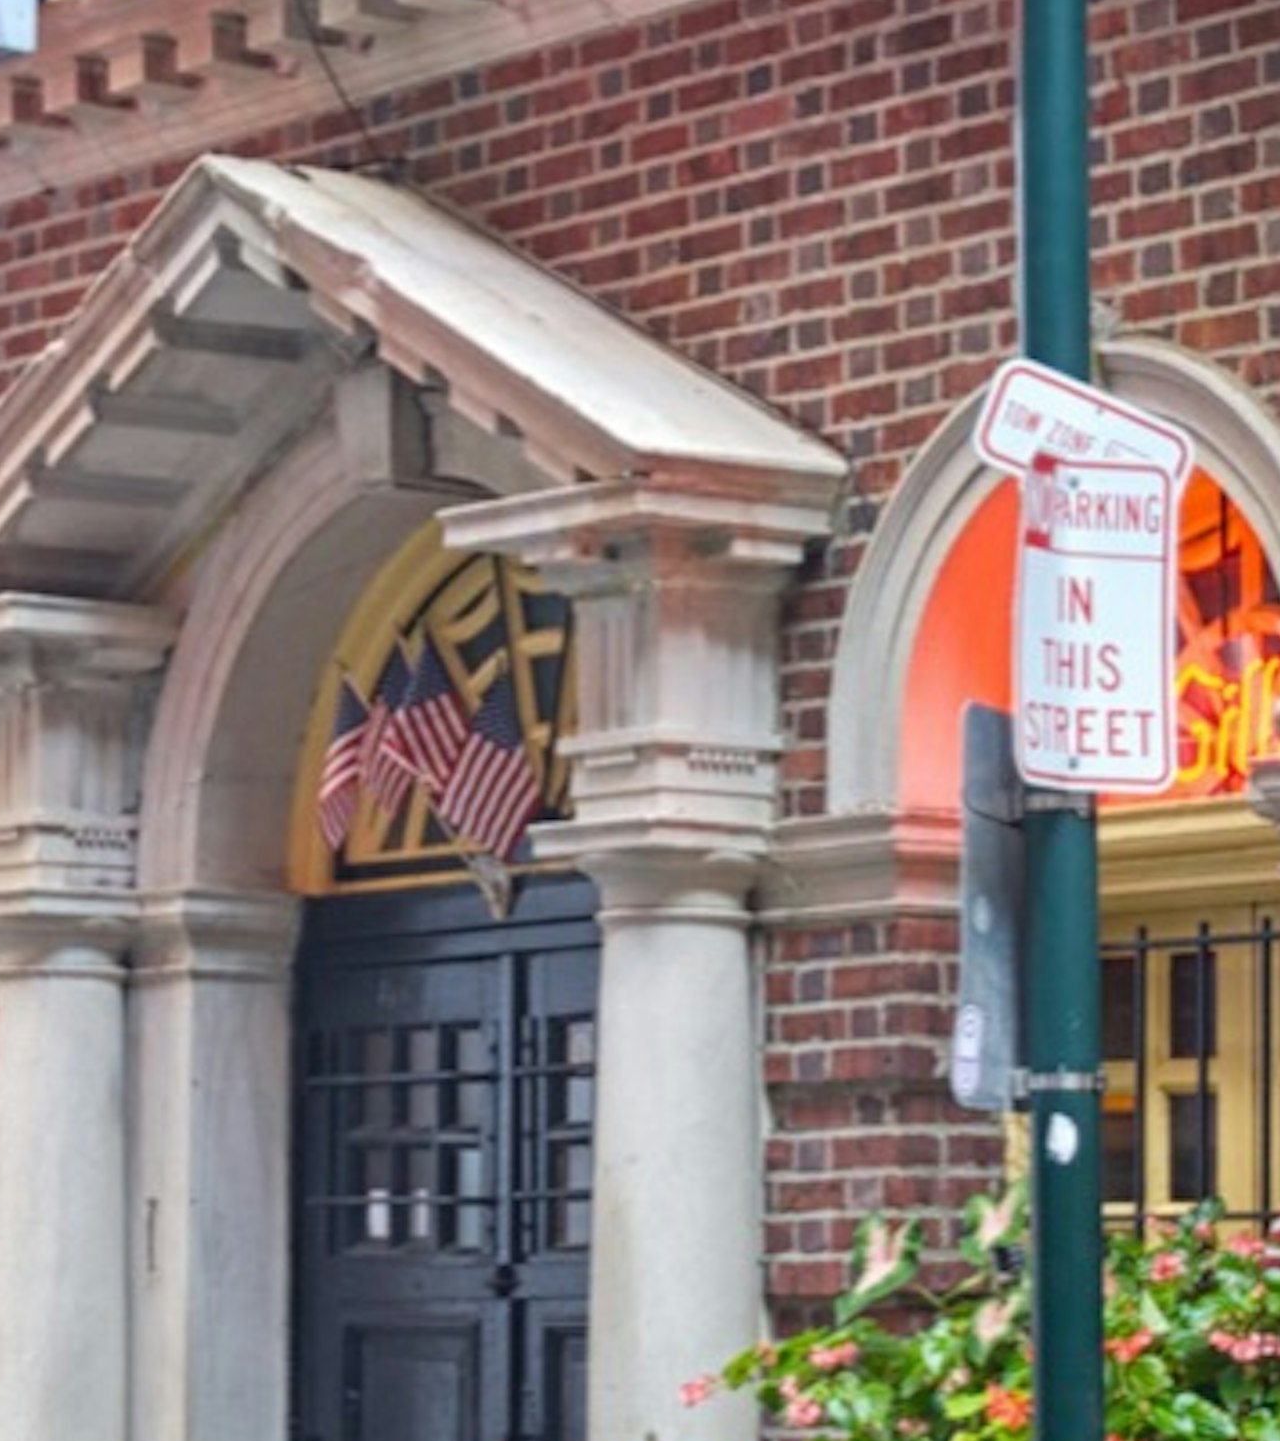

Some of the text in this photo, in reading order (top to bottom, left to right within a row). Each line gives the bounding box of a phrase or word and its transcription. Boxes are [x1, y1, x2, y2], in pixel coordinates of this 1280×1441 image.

[1056, 576, 1093, 625] IN
[1042, 637, 1123, 693] THIS
[1024, 700, 1156, 758] STREET
